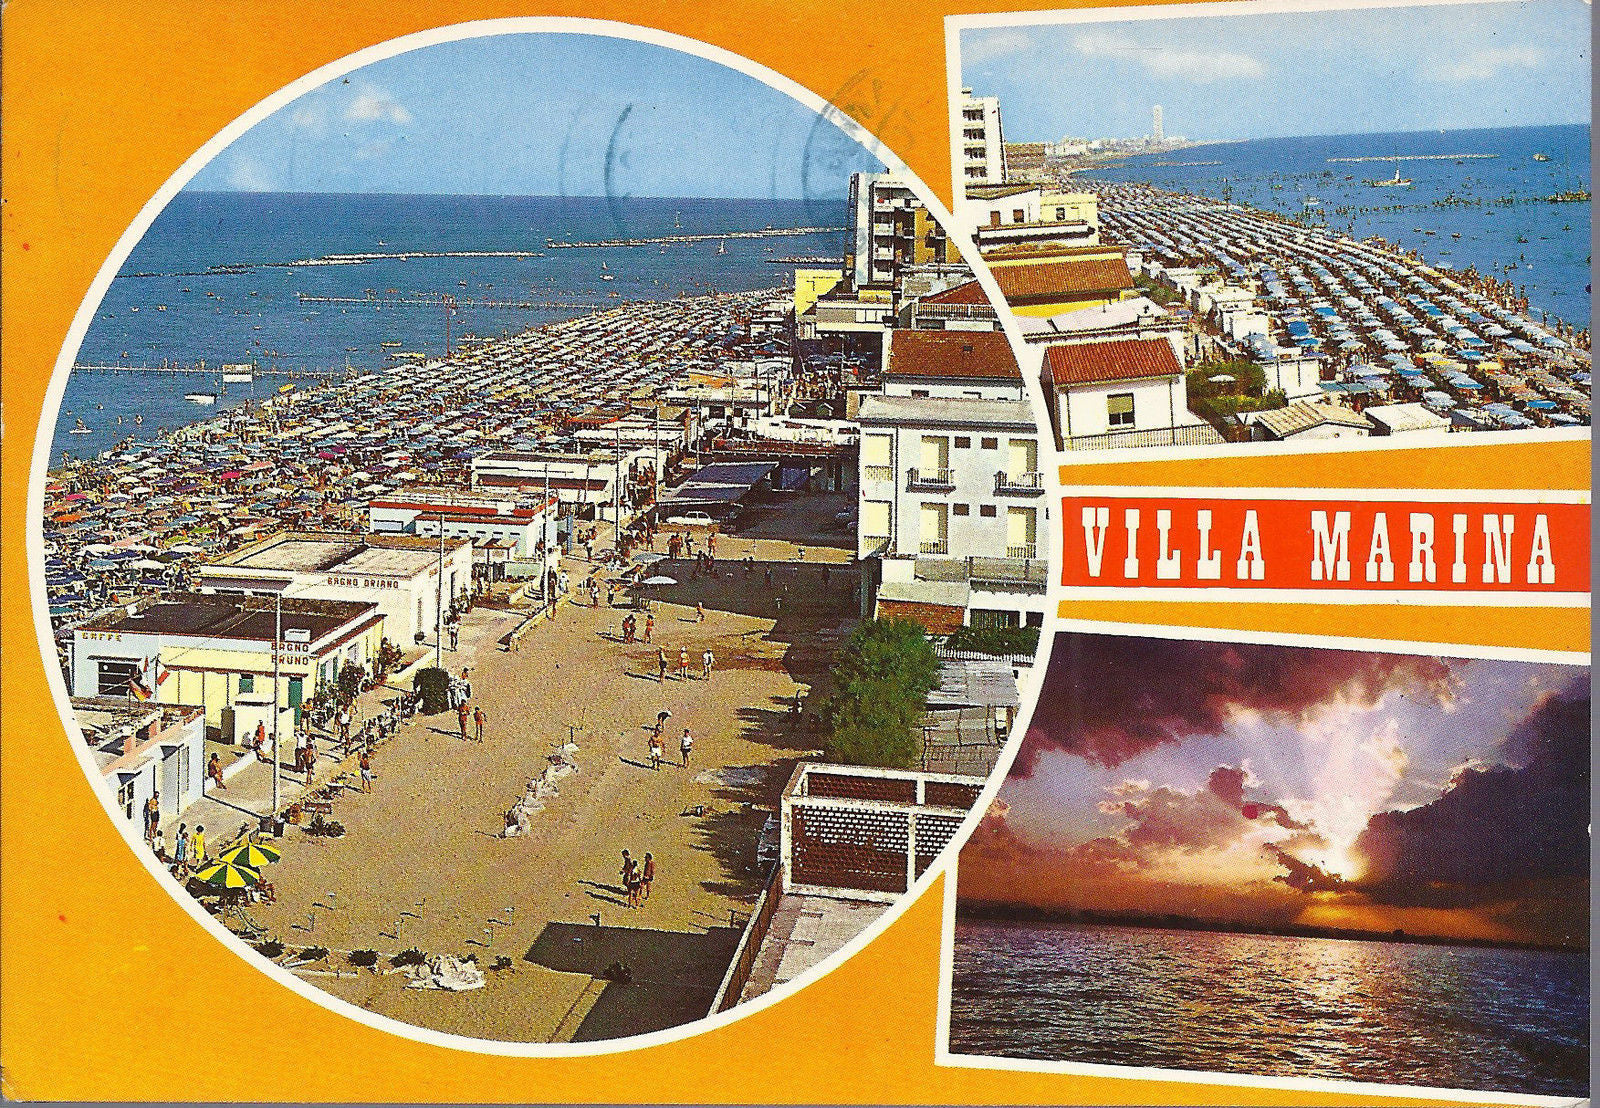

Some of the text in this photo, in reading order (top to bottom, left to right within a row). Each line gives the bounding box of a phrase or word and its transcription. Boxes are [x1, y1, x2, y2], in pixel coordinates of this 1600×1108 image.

[327, 576, 358, 587] BAGNO
[270, 641, 309, 652] BAGNO
[271, 654, 309, 665] BRUNO
